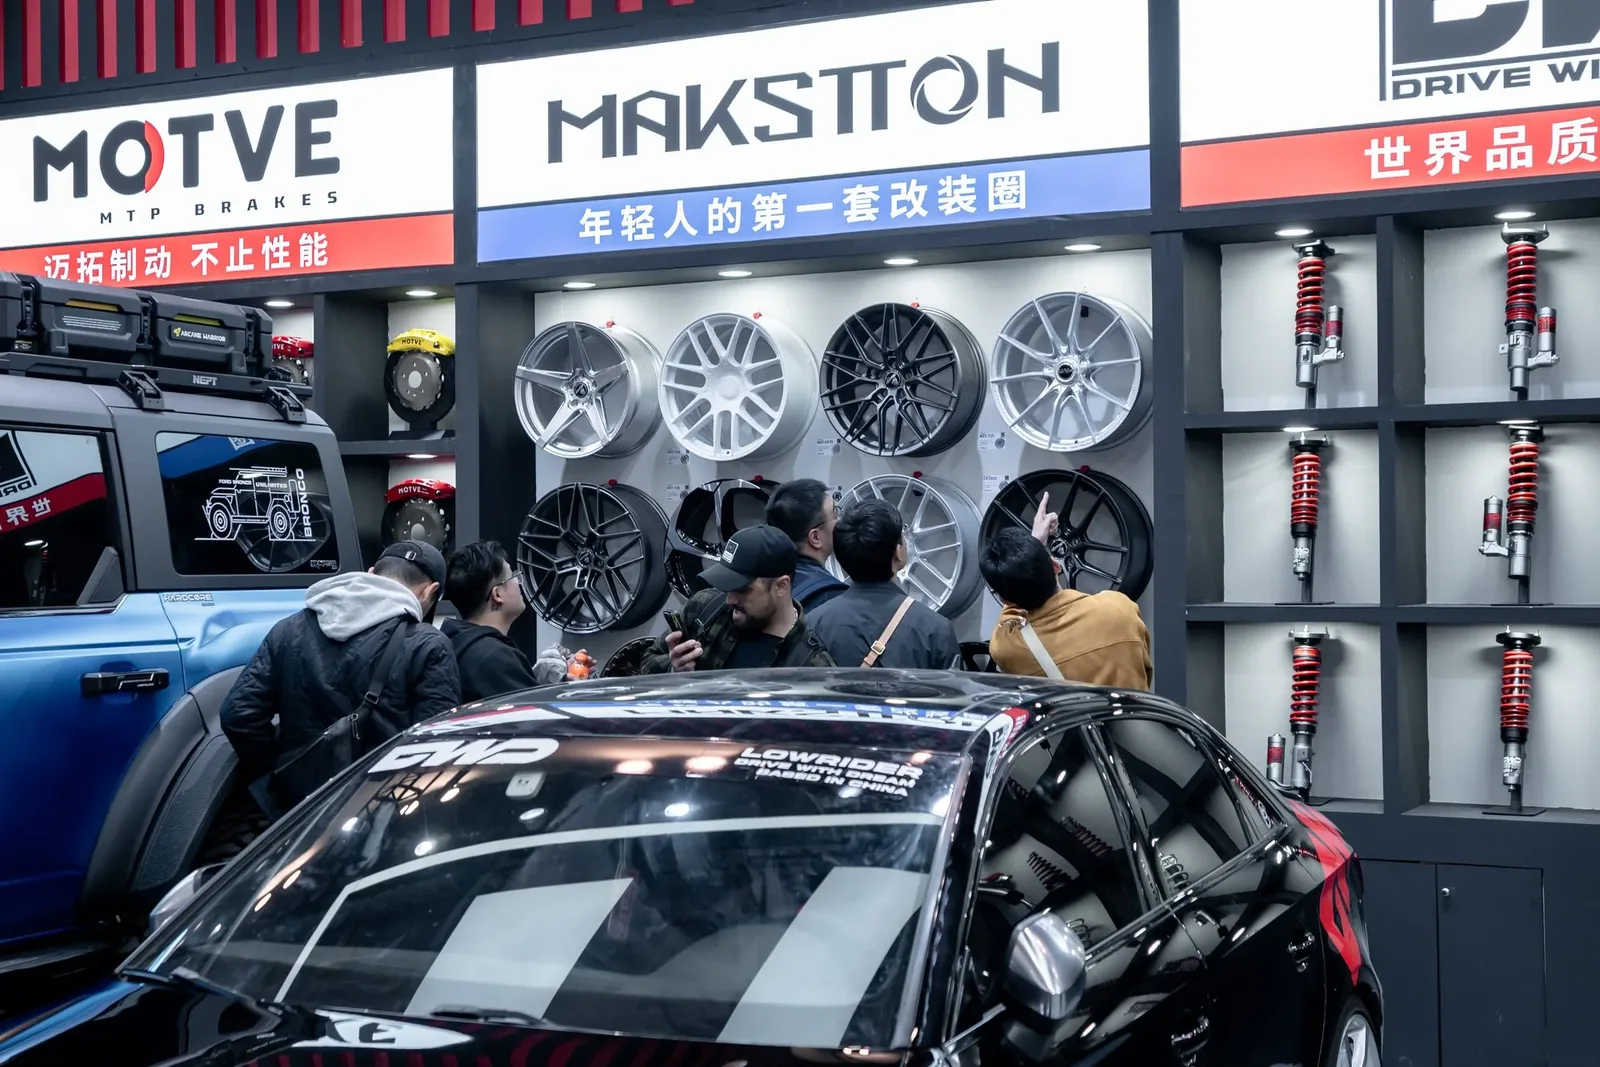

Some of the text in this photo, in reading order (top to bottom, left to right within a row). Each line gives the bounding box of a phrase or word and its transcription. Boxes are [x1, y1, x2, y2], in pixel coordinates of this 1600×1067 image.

[1392, 66, 1531, 101] DRIVE
[33, 98, 340, 203] MOTVE
[1364, 116, 1600, 180] 世界品质
[100, 190, 339, 225] MTP BRAKES
[578, 169, 1027, 245] 年轻人的第一套改装圈
[43, 231, 329, 284] 迈拓制动 不止性能
[401, 338, 422, 346] MOTVE
[255, 481, 288, 489] UNLIMITED
[398, 485, 421, 495] MOTVE
[295, 468, 313, 538] BRONCO
[734, 757, 916, 789] DRIVE WITH DREAM
[741, 746, 924, 780] LOWRIDER
[755, 767, 909, 798] BASED IN CHINA
